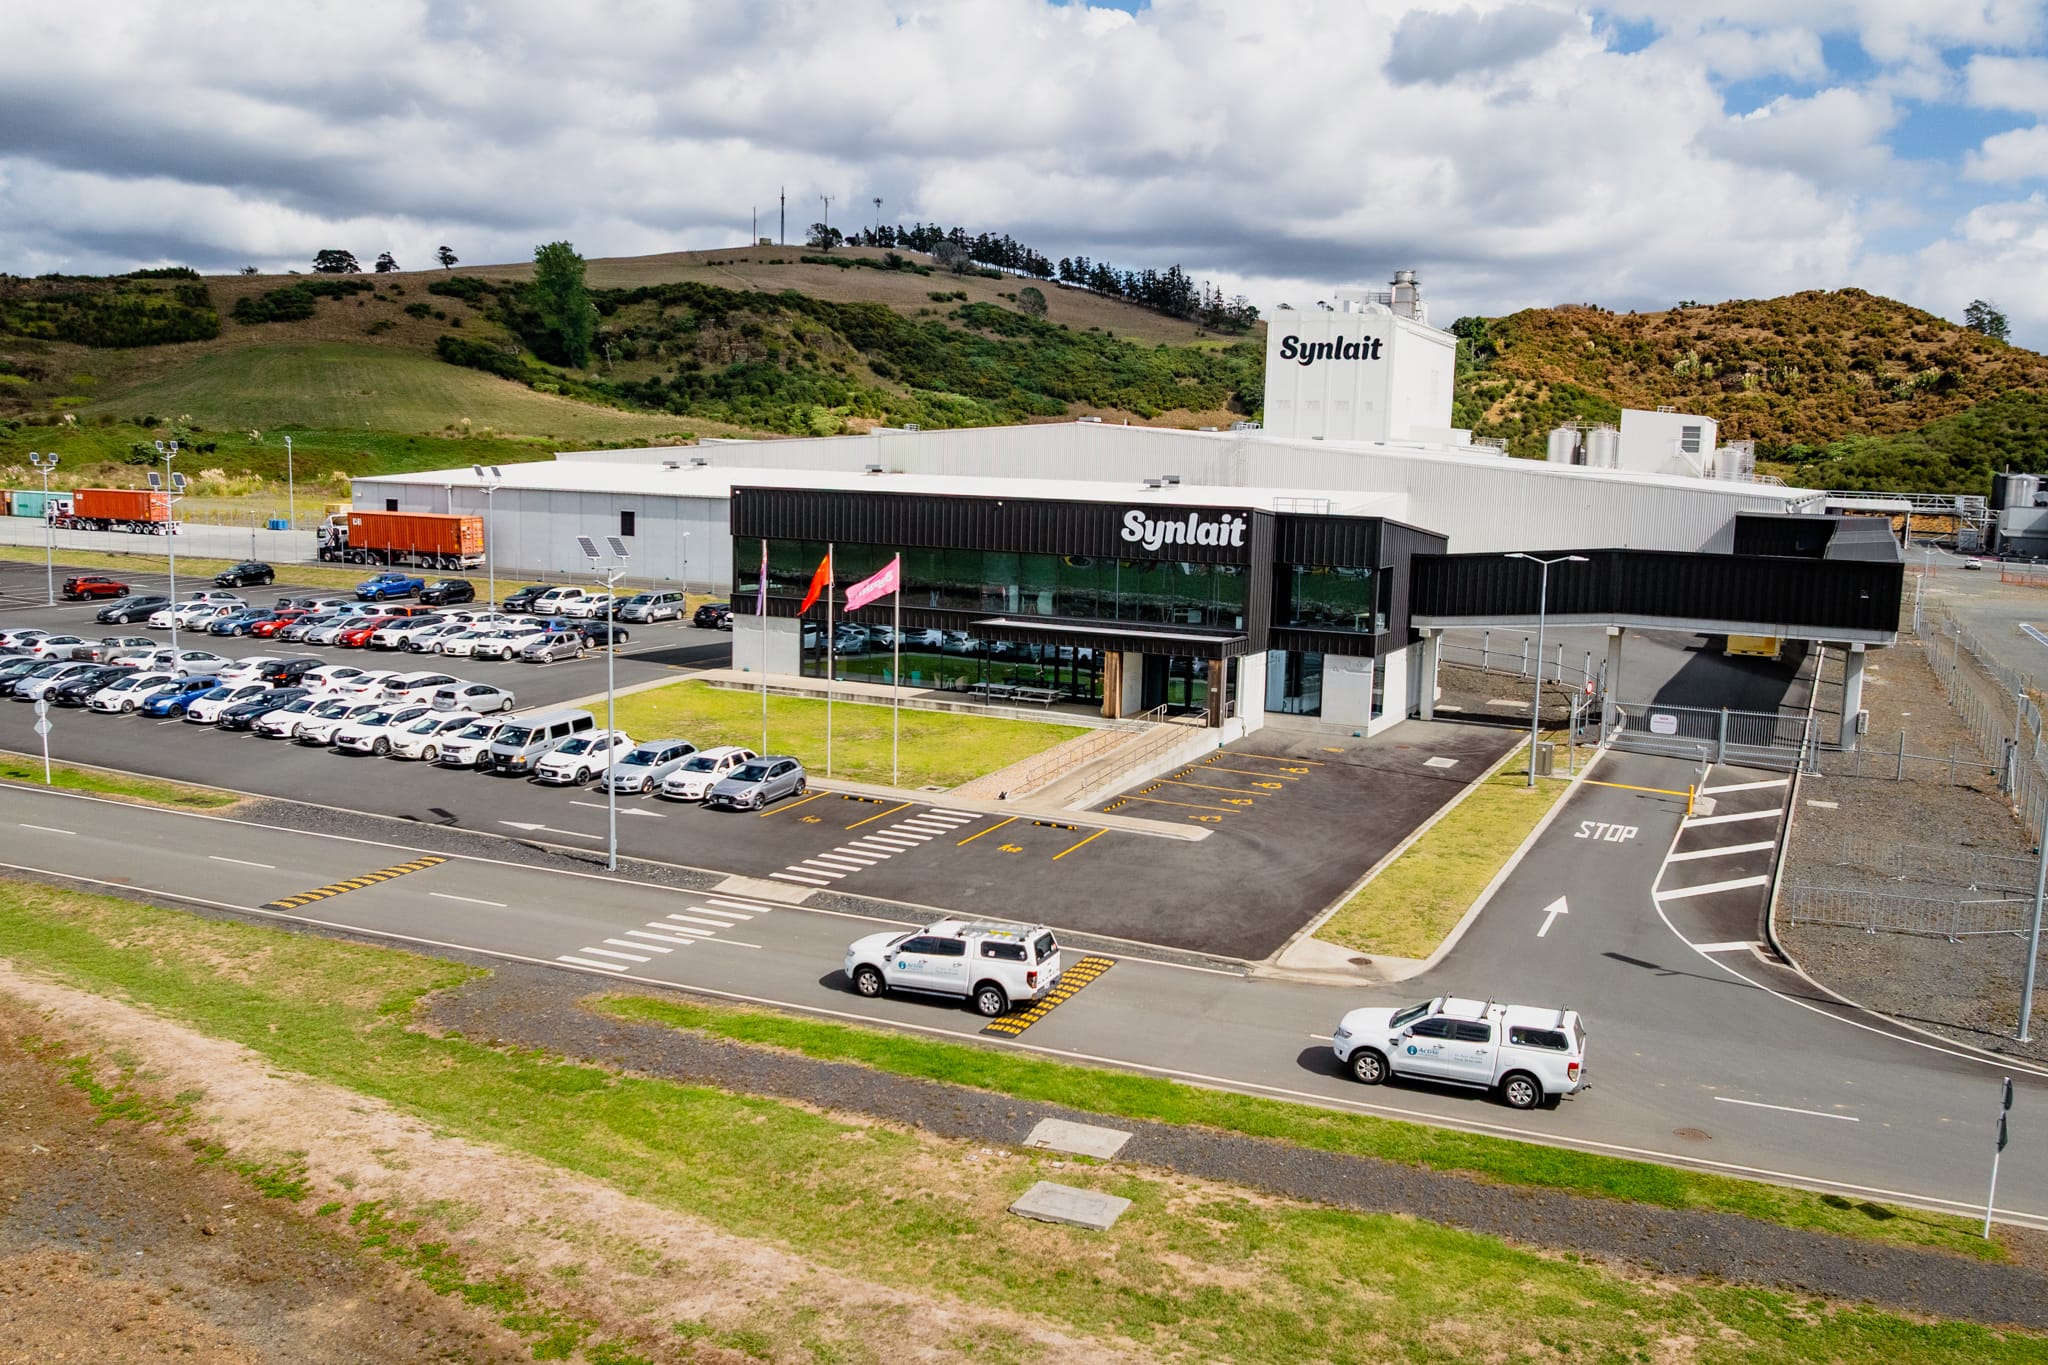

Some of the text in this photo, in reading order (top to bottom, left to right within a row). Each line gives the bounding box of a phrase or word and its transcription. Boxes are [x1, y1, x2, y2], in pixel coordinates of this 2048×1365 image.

[1280, 335, 1383, 366] Synlait
[1121, 510, 1247, 551] Synlait
[1574, 820, 1639, 843] STOP
